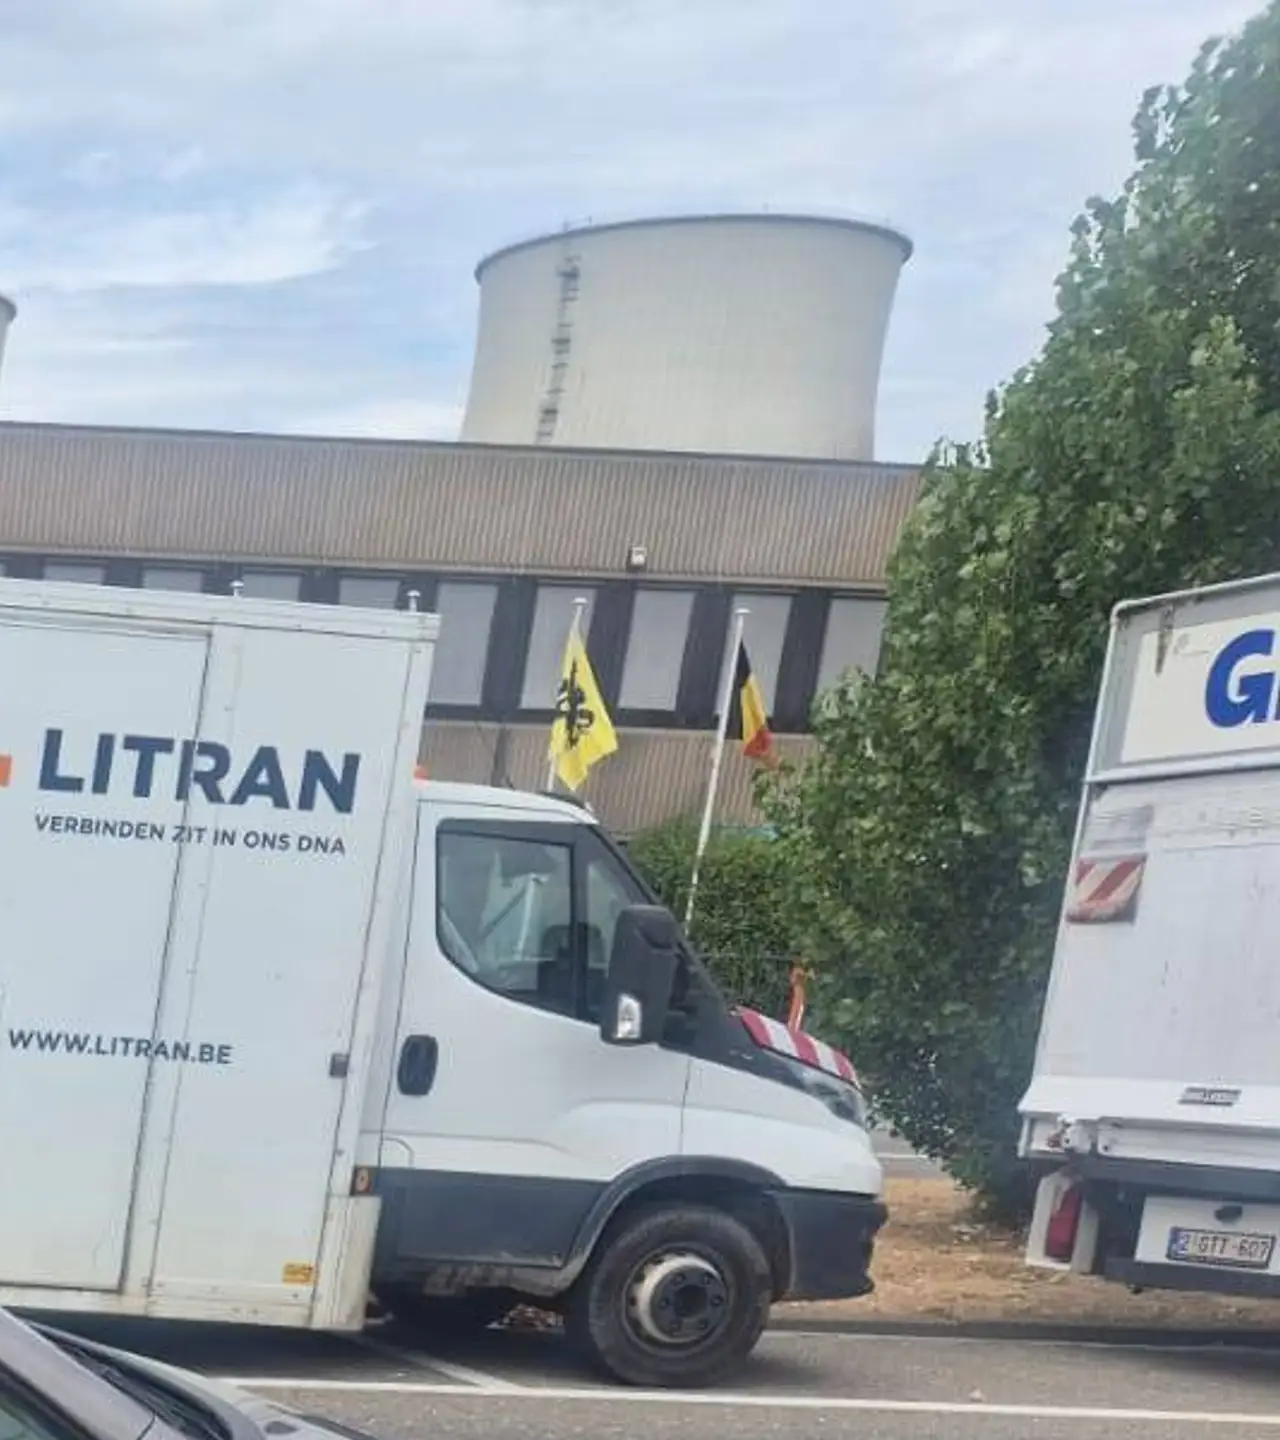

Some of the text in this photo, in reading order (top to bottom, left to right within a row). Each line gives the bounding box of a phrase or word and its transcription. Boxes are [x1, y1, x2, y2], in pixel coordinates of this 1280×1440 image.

[1205, 628, 1280, 728] G
[38, 728, 361, 814] LITRAN
[34, 813, 346, 855] VERBINDEN ZIT IN ONS DNA
[9, 1029, 234, 1064] WWW.LITRAN.BE
